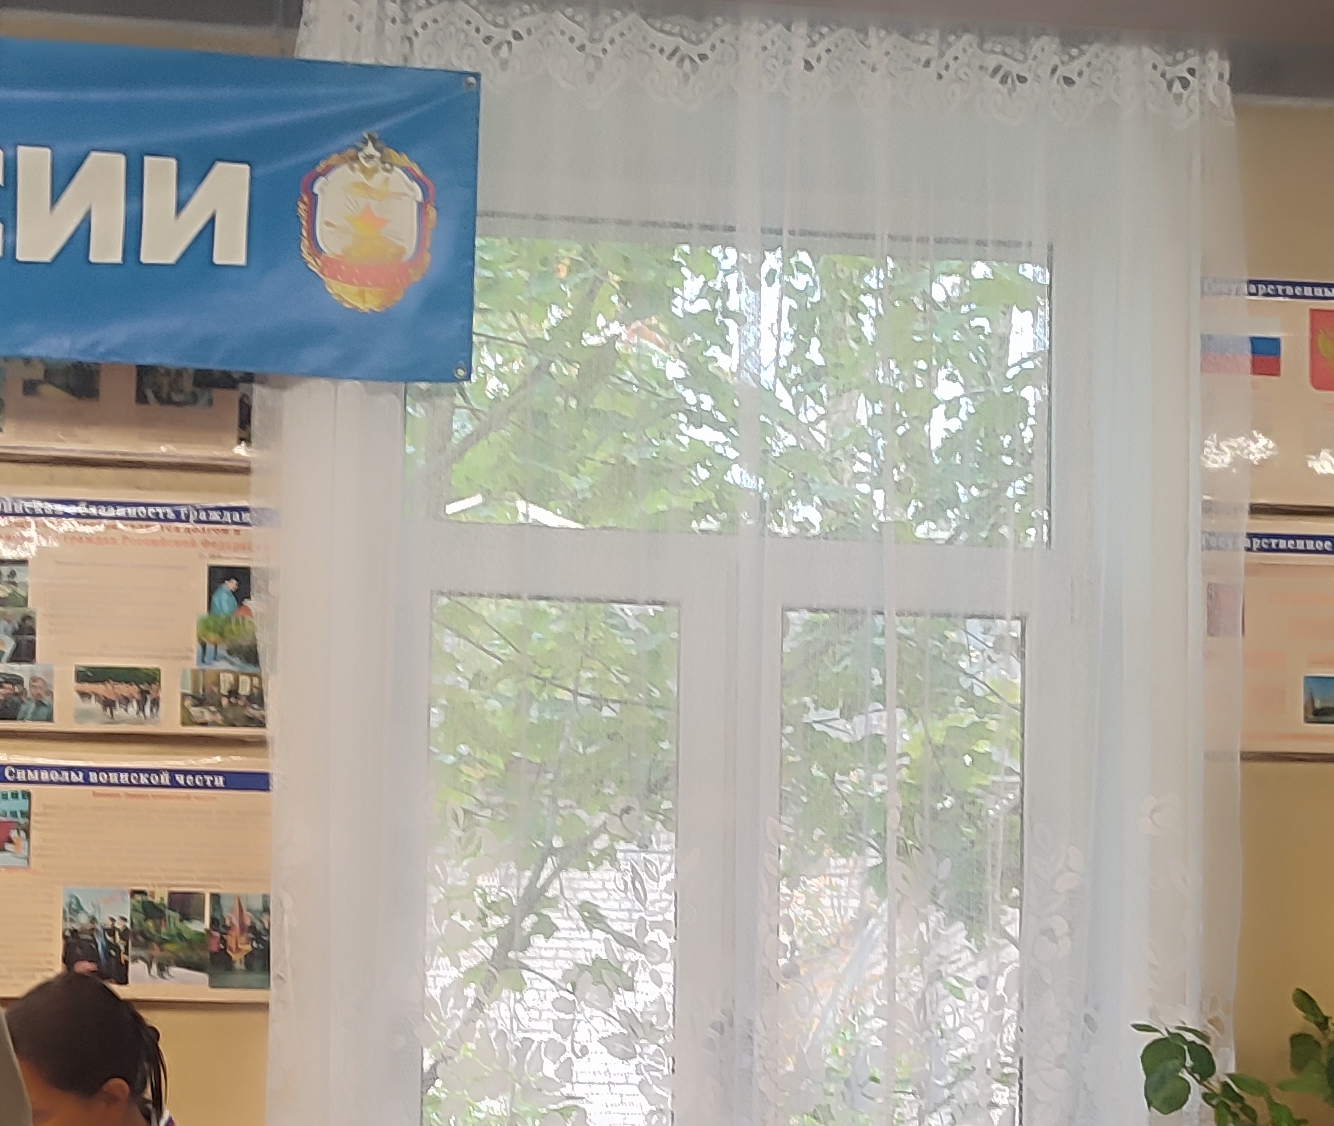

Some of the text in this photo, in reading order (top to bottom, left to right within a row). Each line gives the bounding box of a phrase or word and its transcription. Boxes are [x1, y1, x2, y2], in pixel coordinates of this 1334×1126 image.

[4, 765, 226, 788] Символы воинской чести
